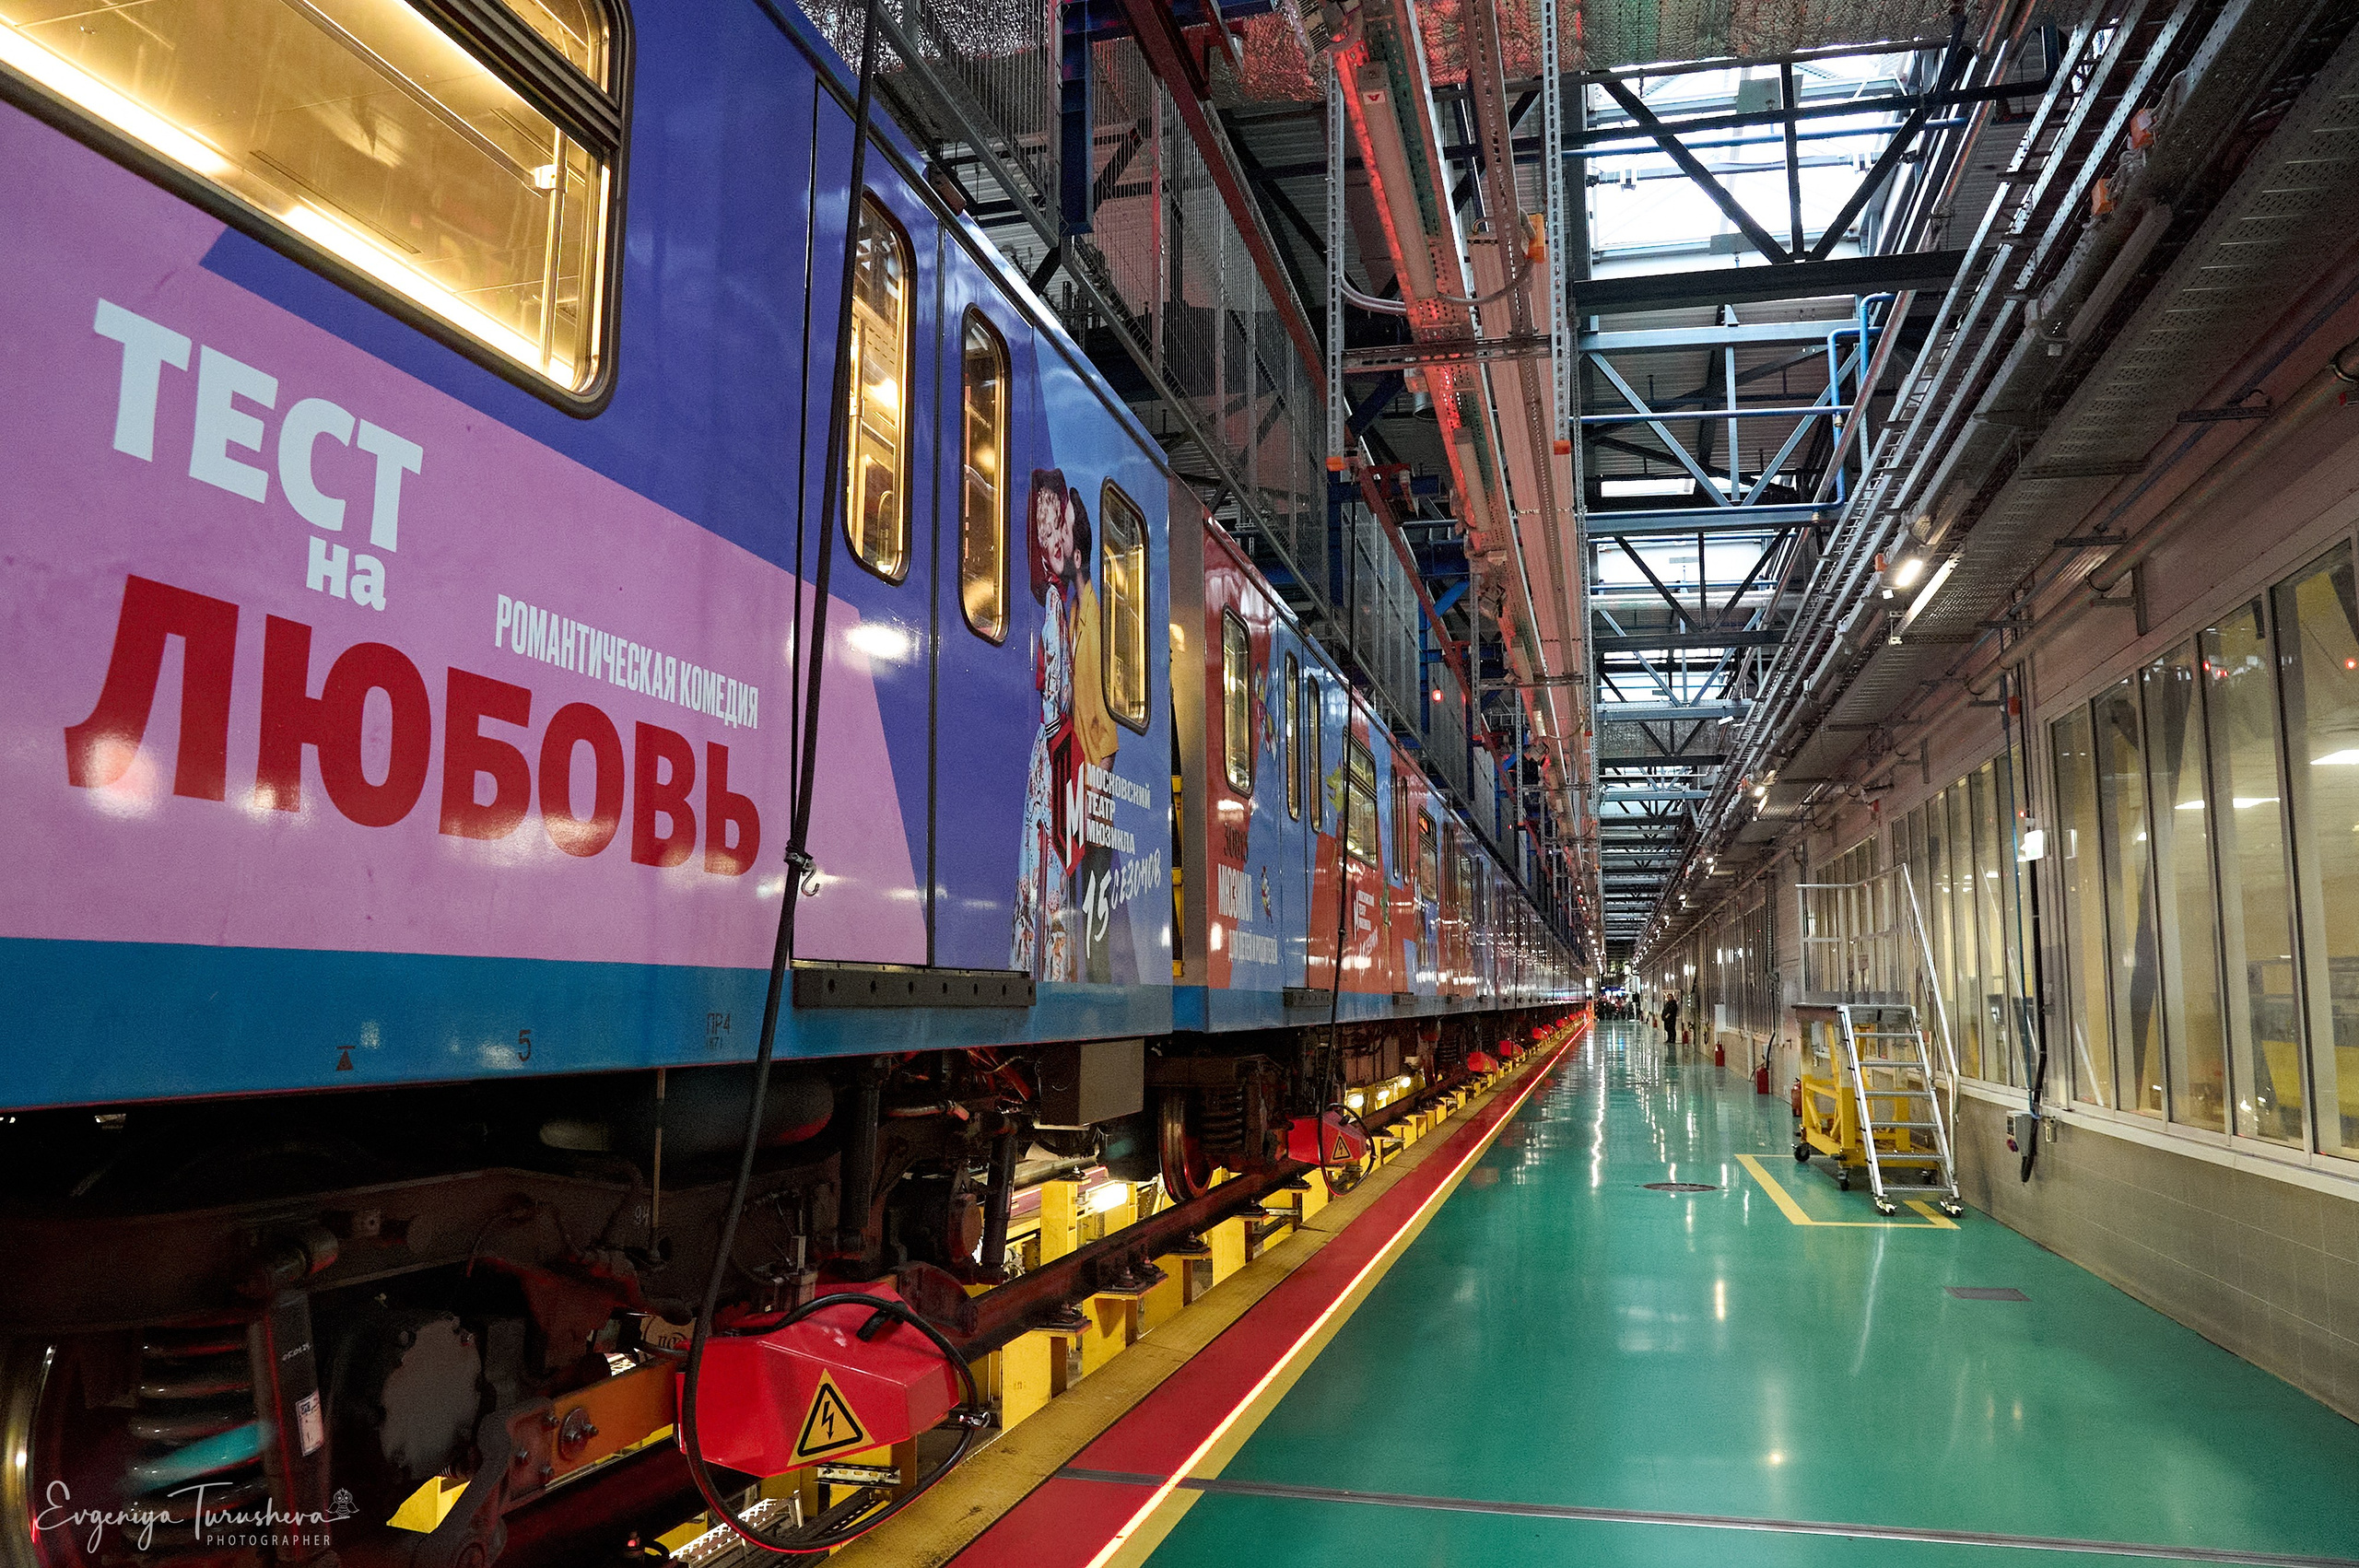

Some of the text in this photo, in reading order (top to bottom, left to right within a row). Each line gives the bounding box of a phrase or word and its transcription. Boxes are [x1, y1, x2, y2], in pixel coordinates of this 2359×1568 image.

[94, 298, 424, 553] ТЕСТ
[306, 534, 387, 612] на
[495, 594, 758, 729] РОМАНТИЧЕСКАЯ КОМЕДИЯ
[64, 575, 762, 877] ЛЮБОВЬ
[1086, 763, 1151, 810] МОСКОВСКИЙ
[1086, 790, 1116, 822] ТЕАТР
[1086, 818, 1136, 855] МЮЗИКЛА
[1082, 848, 1161, 959] 15 СЕЗОНОВ
[1217, 863, 1253, 922] МЮЗИКЛ
[518, 1029, 532, 1061] 5
